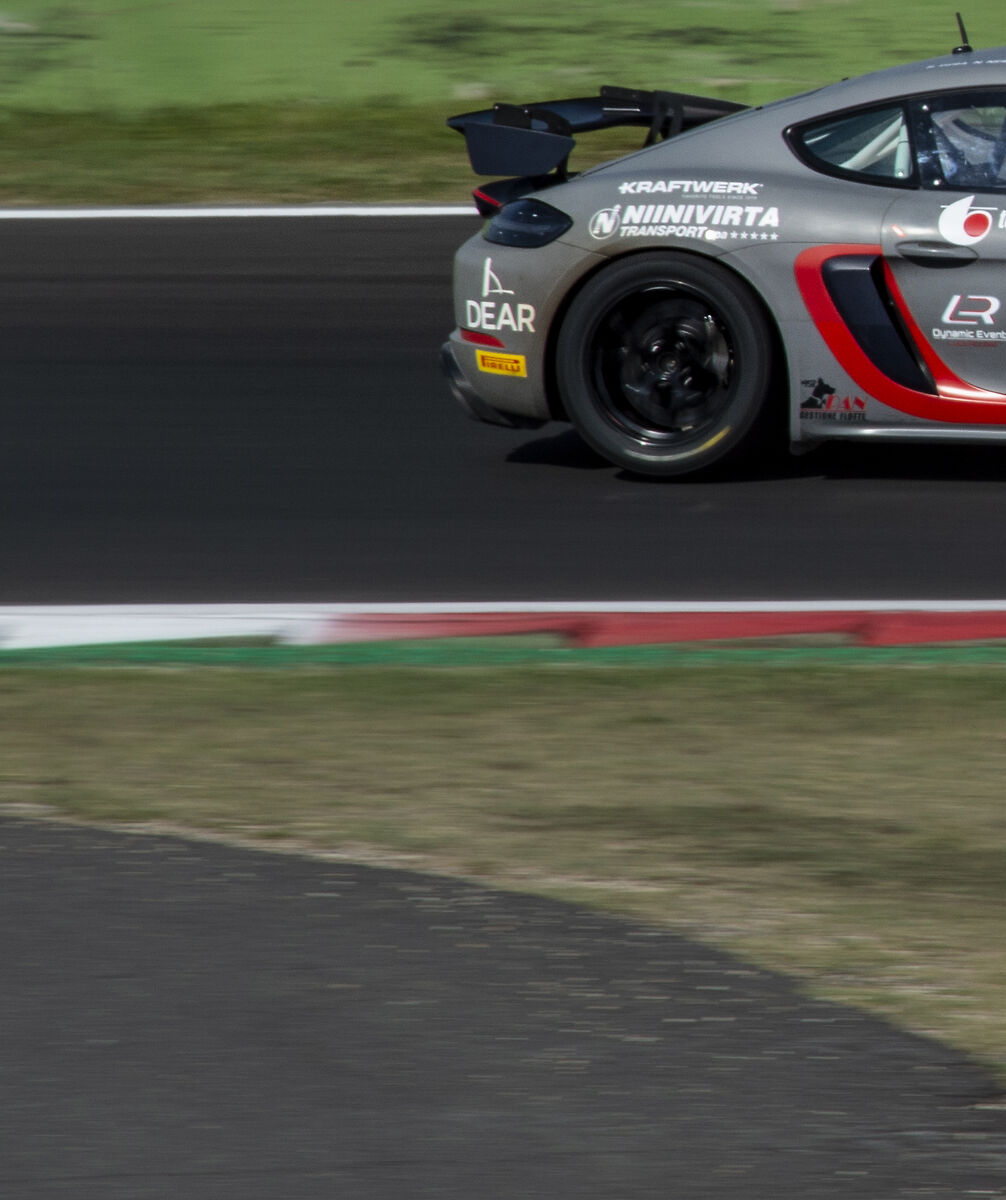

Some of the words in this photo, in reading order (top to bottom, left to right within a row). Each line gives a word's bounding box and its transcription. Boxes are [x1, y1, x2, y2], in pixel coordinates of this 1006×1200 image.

[618, 181, 763, 194] KRAFTWERK
[622, 205, 780, 227] NIINIVIRTA
[620, 226, 708, 238] TRANSPORT
[465, 300, 536, 333] DEAR
[931, 328, 975, 340] Dynamic
[480, 354, 521, 373] PIRELLI
